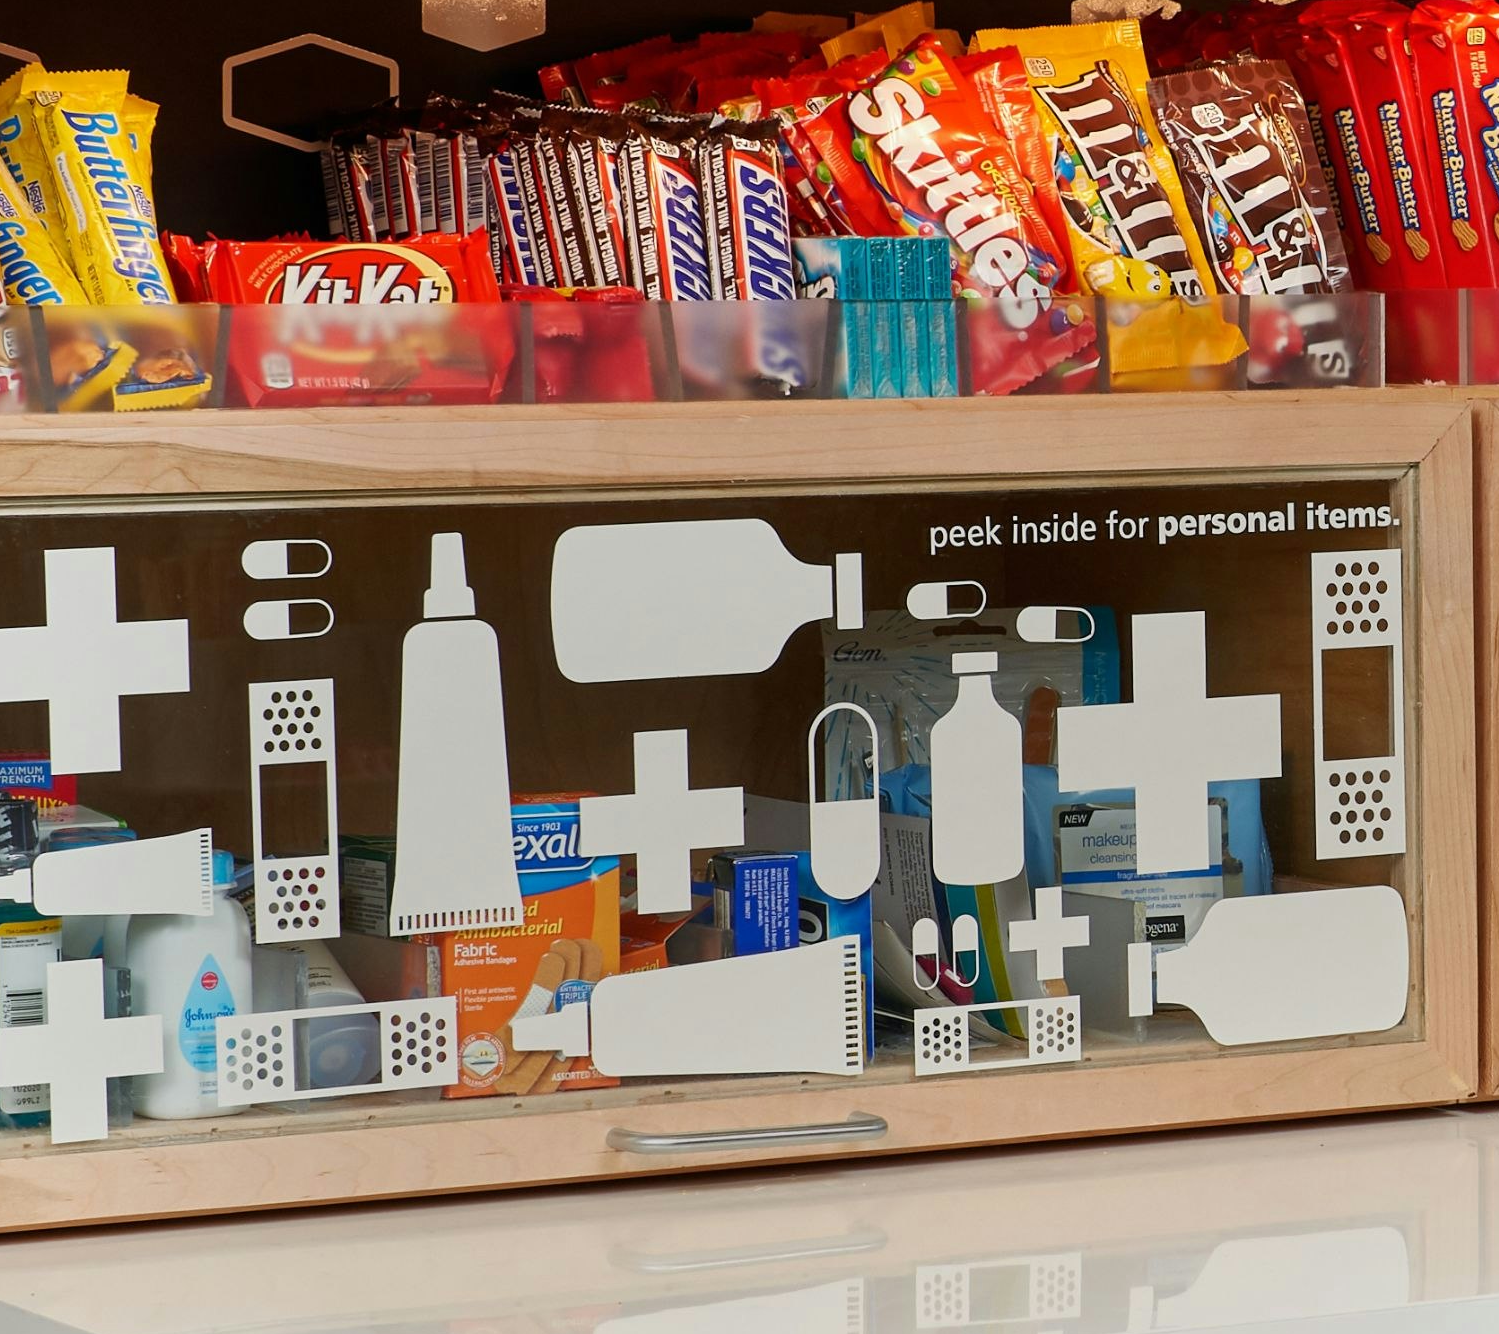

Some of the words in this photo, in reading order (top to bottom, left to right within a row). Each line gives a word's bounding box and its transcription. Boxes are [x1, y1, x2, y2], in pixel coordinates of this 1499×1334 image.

[1034, 57, 1053, 77] 250
[1204, 106, 1222, 125] 230
[1438, 90, 1458, 158] Nutter
[1448, 154, 1469, 219] Butter
[1339, 107, 1363, 172] Nutter
[1355, 170, 1381, 233] Butter
[1383, 101, 1406, 168] Nutter
[1398, 165, 1420, 230] Butter
[848, 77, 1052, 330] Skittles
[929, 516, 1002, 555] peek
[1012, 512, 1097, 544] inside
[1105, 510, 1150, 540] for
[1158, 502, 1295, 544] personal
[1306, 502, 1401, 531] items.
[516, 823, 539, 833] Since
[541, 822, 561, 832] 1903
[1063, 814, 1088, 825] NEW
[1157, 901, 1182, 910] mascara
[454, 943, 497, 958] Fabric
[453, 957, 485, 967] Adhesive
[485, 956, 517, 965] Bandages
[560, 992, 588, 1001] TRIPLE
[552, 1072, 590, 1082] ASSORTED
